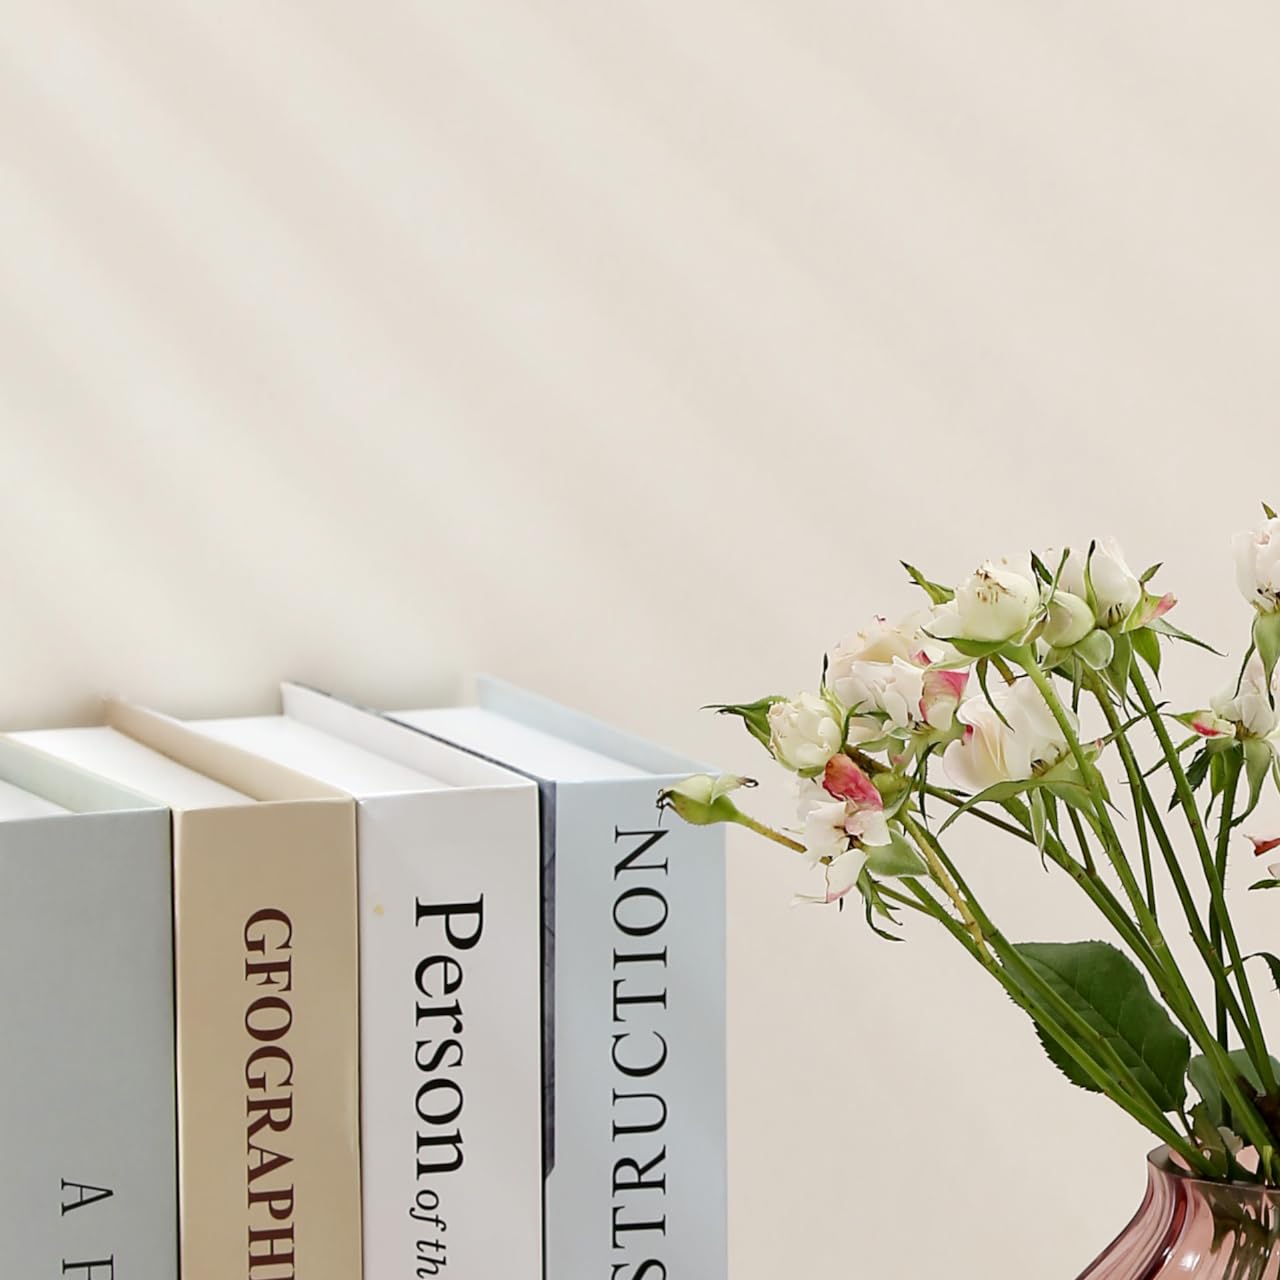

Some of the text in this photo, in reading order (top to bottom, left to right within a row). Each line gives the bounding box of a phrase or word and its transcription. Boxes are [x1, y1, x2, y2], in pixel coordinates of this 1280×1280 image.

[415, 893, 484, 1181] Person
[61, 1178, 114, 1216] A
[409, 1189, 447, 1232] of
